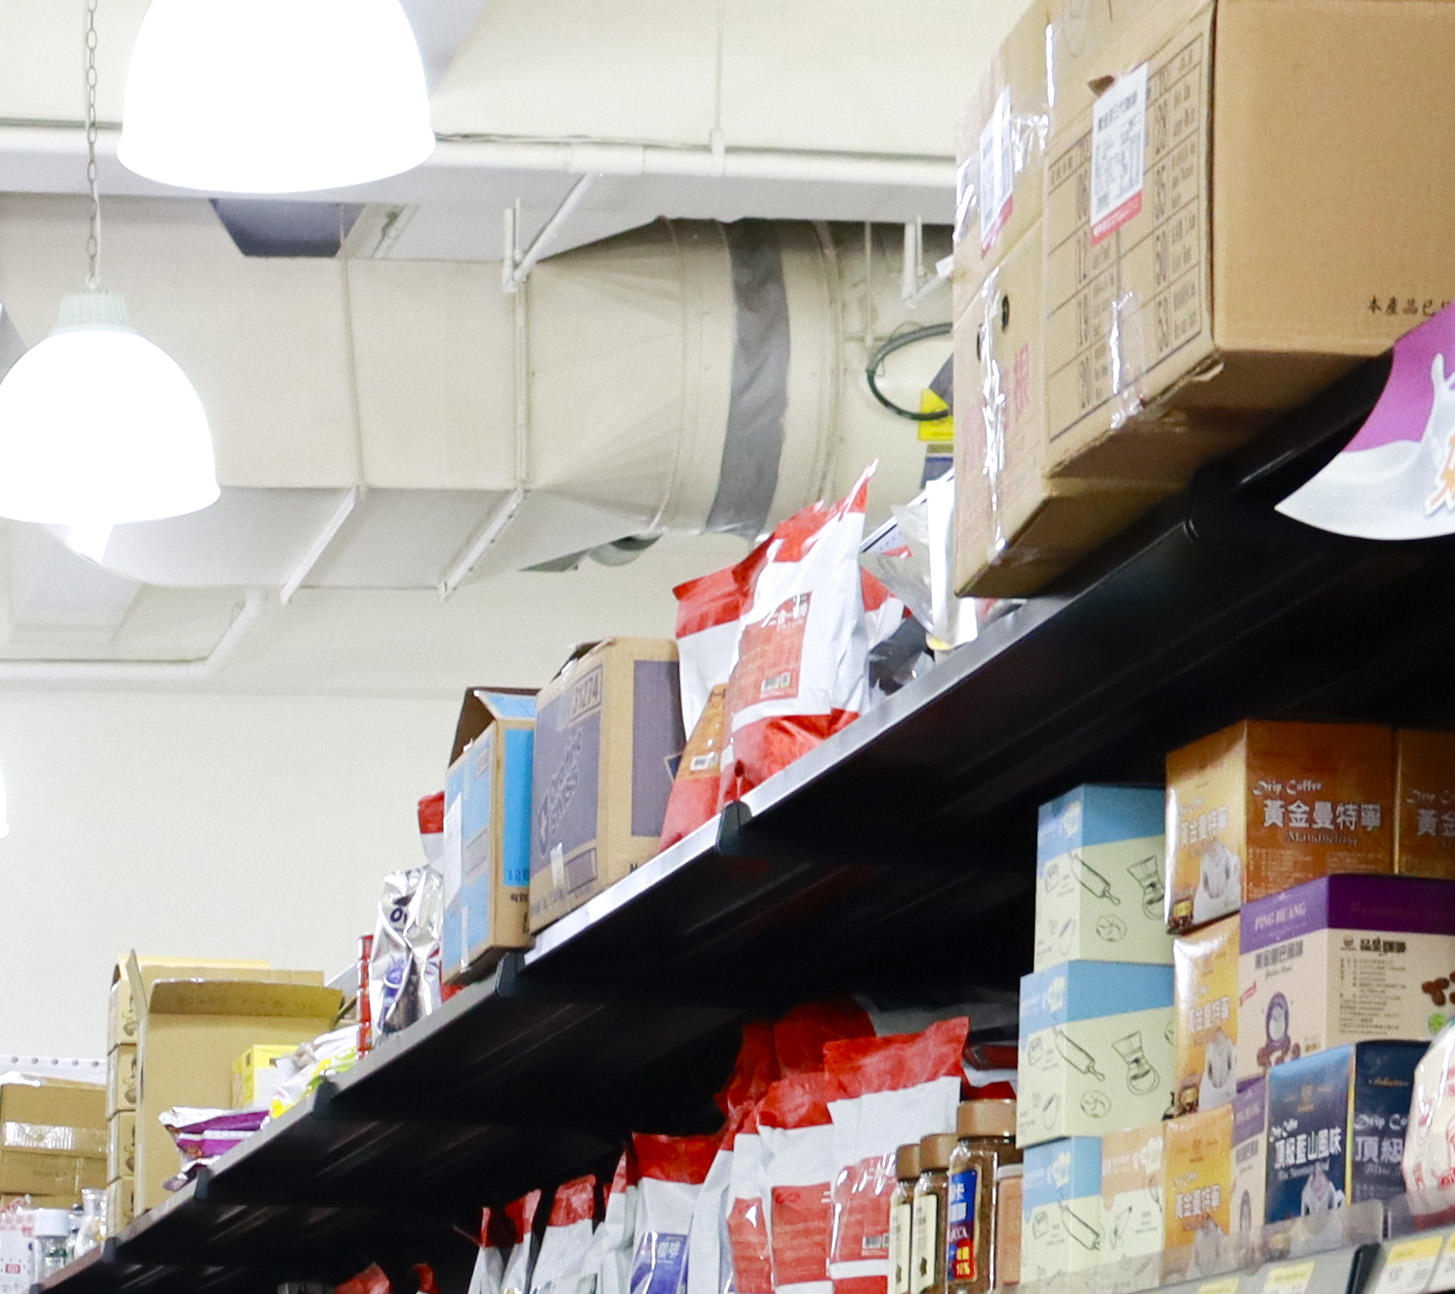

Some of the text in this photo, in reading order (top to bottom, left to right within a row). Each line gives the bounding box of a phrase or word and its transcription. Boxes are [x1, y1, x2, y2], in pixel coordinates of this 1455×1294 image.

[1263, 799, 1381, 832] 黃金曼特寧
